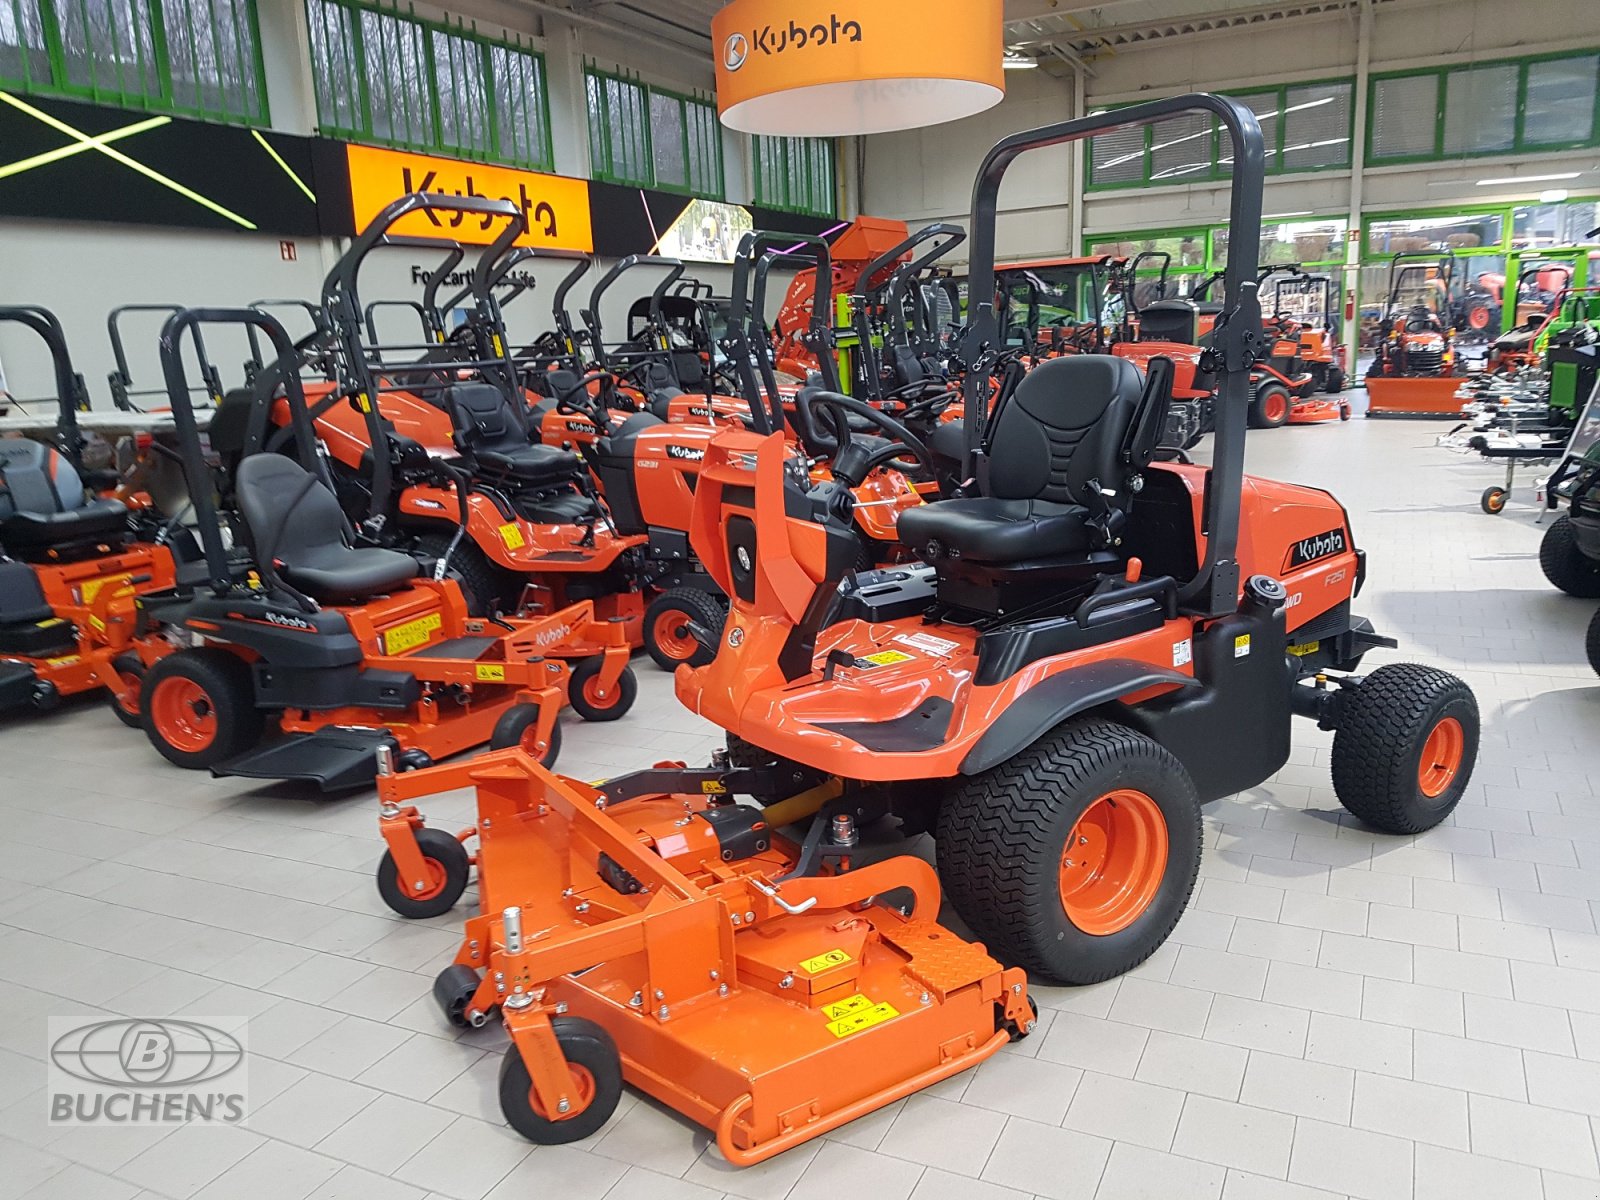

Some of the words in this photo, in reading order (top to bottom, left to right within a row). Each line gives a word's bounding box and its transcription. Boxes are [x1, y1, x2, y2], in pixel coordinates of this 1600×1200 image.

[753, 13, 862, 55] Kubota
[402, 166, 558, 238] Kubta
[691, 407, 715, 418] Kuboa
[569, 420, 596, 434] Kubota
[1299, 531, 1343, 560] Kubota
[1283, 592, 1302, 609] WD
[265, 611, 308, 629] Kubota
[536, 624, 570, 646] Kubota
